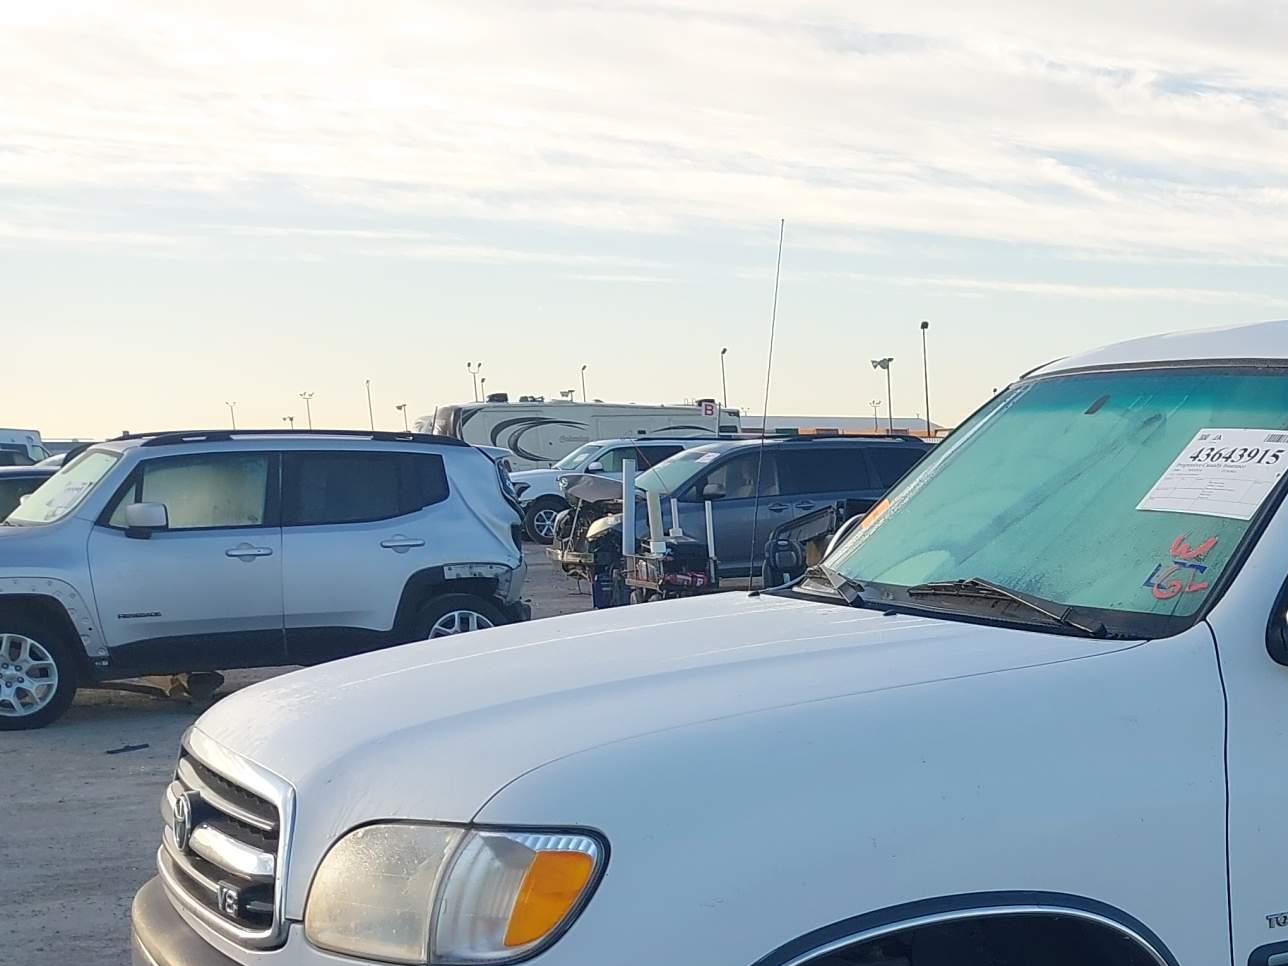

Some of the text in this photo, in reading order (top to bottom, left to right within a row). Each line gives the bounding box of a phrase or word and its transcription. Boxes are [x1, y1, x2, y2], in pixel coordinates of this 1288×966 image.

[704, 404, 714, 416] B
[1190, 447, 1286, 465] 43643915
[217, 884, 239, 918] V8
